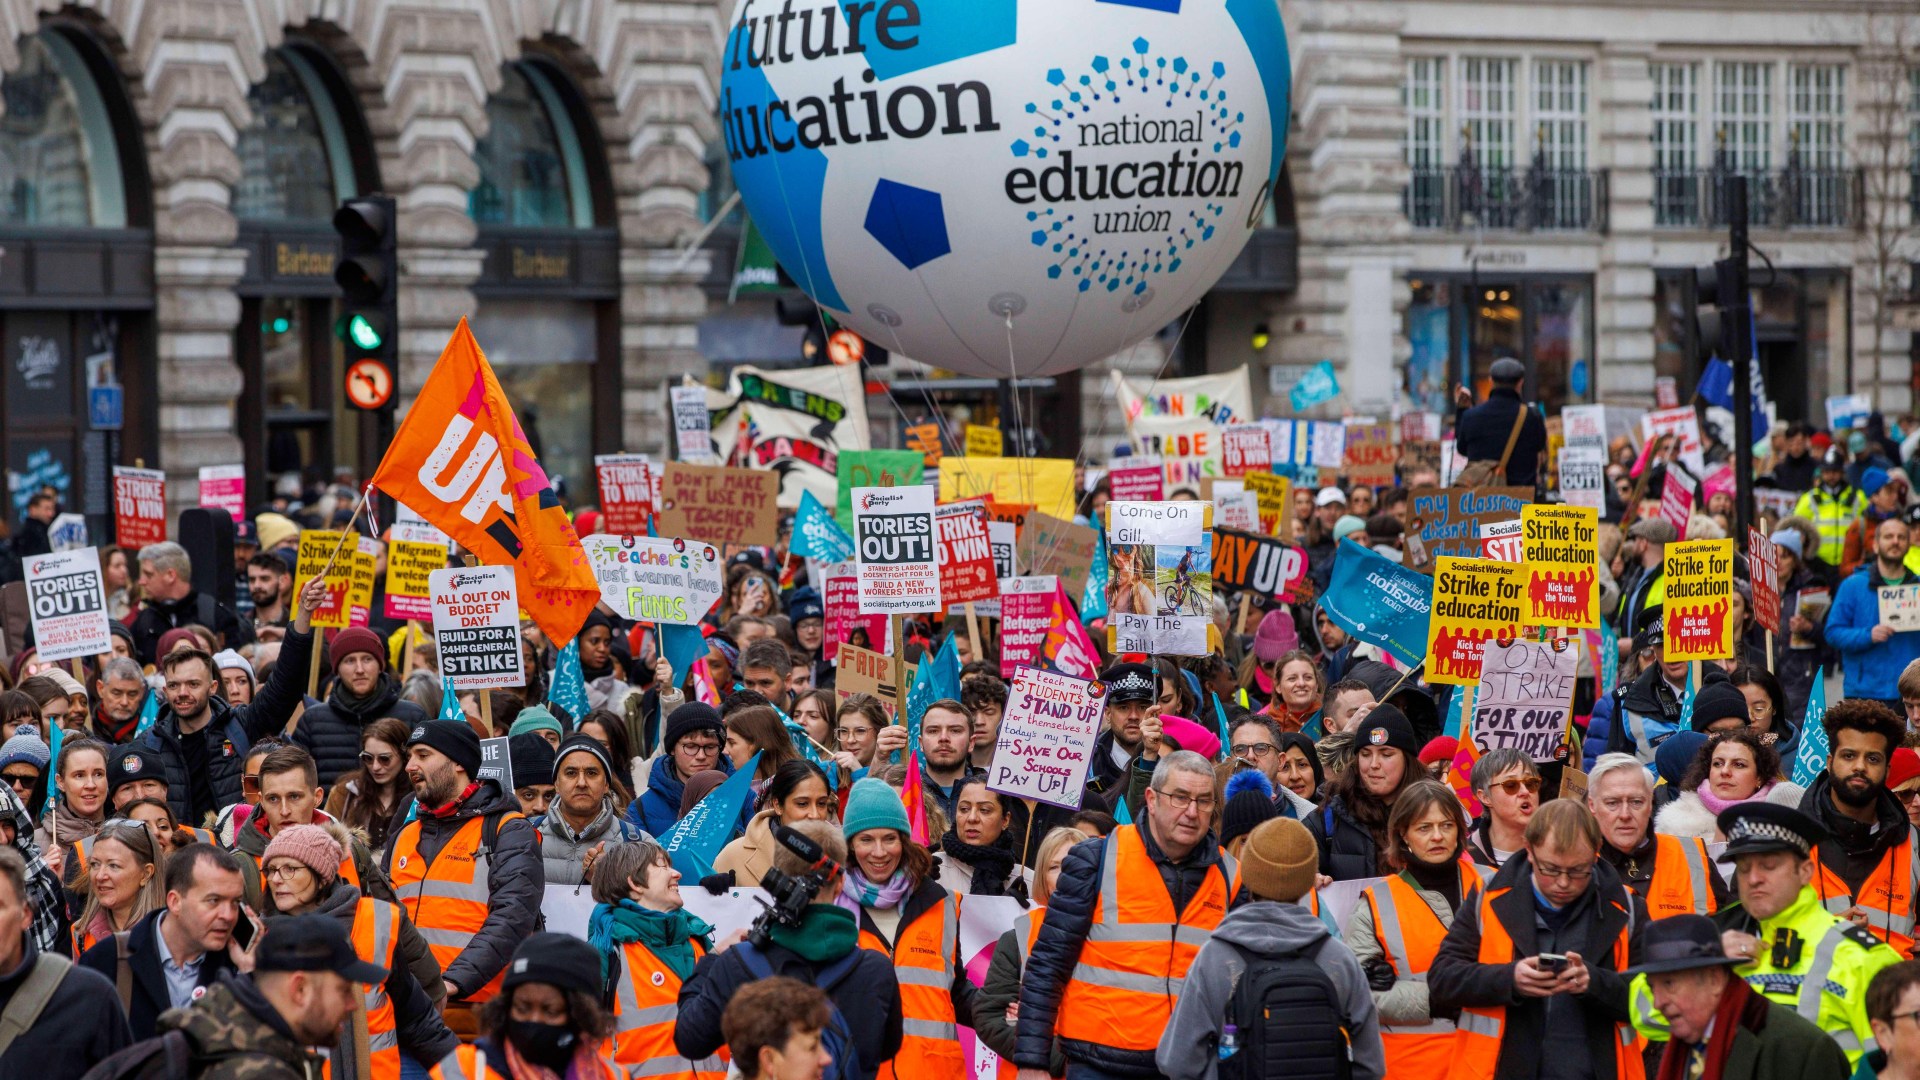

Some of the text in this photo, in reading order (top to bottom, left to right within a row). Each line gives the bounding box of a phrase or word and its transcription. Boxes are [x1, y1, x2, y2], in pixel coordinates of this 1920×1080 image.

[730, 0, 921, 70] future
[722, 68, 1000, 163] ducation
[1078, 112, 1203, 148] national
[1005, 150, 1243, 204] education
[1093, 205, 1171, 234] union
[277, 244, 335, 275] Barbour
[1142, 433, 1207, 456] TRADE
[1224, 434, 1268, 447] STRIKE
[1226, 450, 1269, 466] TO WIN
[600, 466, 647, 483] STRIKE
[723, 475, 764, 490] MAKE
[1166, 460, 1215, 484] IONS
[117, 478, 162, 499] STRIKE
[601, 485, 620, 502] TO
[623, 485, 650, 502] WIN
[676, 489, 698, 500] ME
[706, 488, 735, 506] USE
[742, 491, 767, 509] MY
[117, 497, 164, 520] TO WIN
[680, 506, 755, 528] TEACHER
[1119, 504, 1188, 520] Come On
[1415, 495, 1448, 527] my
[685, 526, 745, 544] VOICE!
[860, 516, 930, 535] TORIES
[936, 514, 985, 542] TRIKE
[1118, 528, 1145, 544] Gill,
[1421, 520, 1467, 541] doesn't
[1526, 519, 1594, 542] Strike for
[301, 542, 354, 560] Strike for
[396, 543, 441, 558] Migrants
[603, 546, 689, 569] Teachers
[862, 535, 930, 560] OUT!
[952, 536, 989, 563] WIN
[1211, 531, 1259, 585] PAY
[1527, 541, 1594, 564] education
[1750, 530, 1777, 569] STRIKE
[391, 557, 397, 566] &
[945, 564, 974, 577] all need
[1667, 555, 1729, 577] Strike for
[31, 573, 97, 596] TORIES
[458, 573, 496, 581] Socialist
[596, 564, 720, 594] just wanna have
[941, 577, 970, 589] pay rise
[1750, 554, 1778, 595] TO WIN
[864, 588, 904, 596] WORKERS'
[960, 586, 991, 599] together
[1438, 572, 1523, 599] Strike for
[1548, 582, 1573, 593] Kick out
[1666, 576, 1729, 598] education
[35, 588, 100, 617] OUT!
[436, 590, 511, 605] ALL OUT ON
[627, 587, 687, 621] FUNDS
[828, 595, 843, 605] out
[863, 599, 936, 610] socialistparty.org.uk
[1004, 595, 1041, 605] Say it loud
[1545, 592, 1576, 603] the Tories
[449, 603, 500, 616] BUDGET
[1003, 606, 1016, 616] Say
[1018, 605, 1025, 614] it
[1026, 604, 1046, 613] clear:
[1436, 597, 1519, 622] education
[461, 616, 490, 627] DAY!
[1125, 616, 1181, 632] Pay The
[1681, 626, 1710, 637] the Tories
[1683, 617, 1708, 627] Kick out
[48, 630, 71, 639] BUILD
[79, 626, 96, 634] NEW
[82, 631, 105, 640] PARTY
[440, 629, 515, 643] BUILD FOR A
[1003, 630, 1045, 645] welcom
[41, 641, 107, 657] socialistparty.org.uk
[441, 642, 516, 654] 24HR GENERAL
[1003, 648, 1030, 661] here
[1452, 650, 1465, 659] the
[1457, 639, 1474, 650] Kick
[444, 653, 517, 672] STRIKE
[841, 648, 888, 681] FAIR
[1504, 643, 1557, 669] ON
[1016, 666, 1084, 694] I teach my
[1478, 671, 1574, 702] STRIKE
[1014, 680, 1099, 708] STUDENTS to
[1020, 694, 1098, 723] STAND UP
[1475, 707, 1564, 731] FOR OUR
[1007, 709, 1080, 733] for themselves
[1004, 723, 1037, 741] today's
[1044, 733, 1058, 745] my
[482, 744, 499, 761] HE
[125, 762, 135, 771] UP
[667, 796, 708, 852] ducation
[689, 808, 711, 838] national
